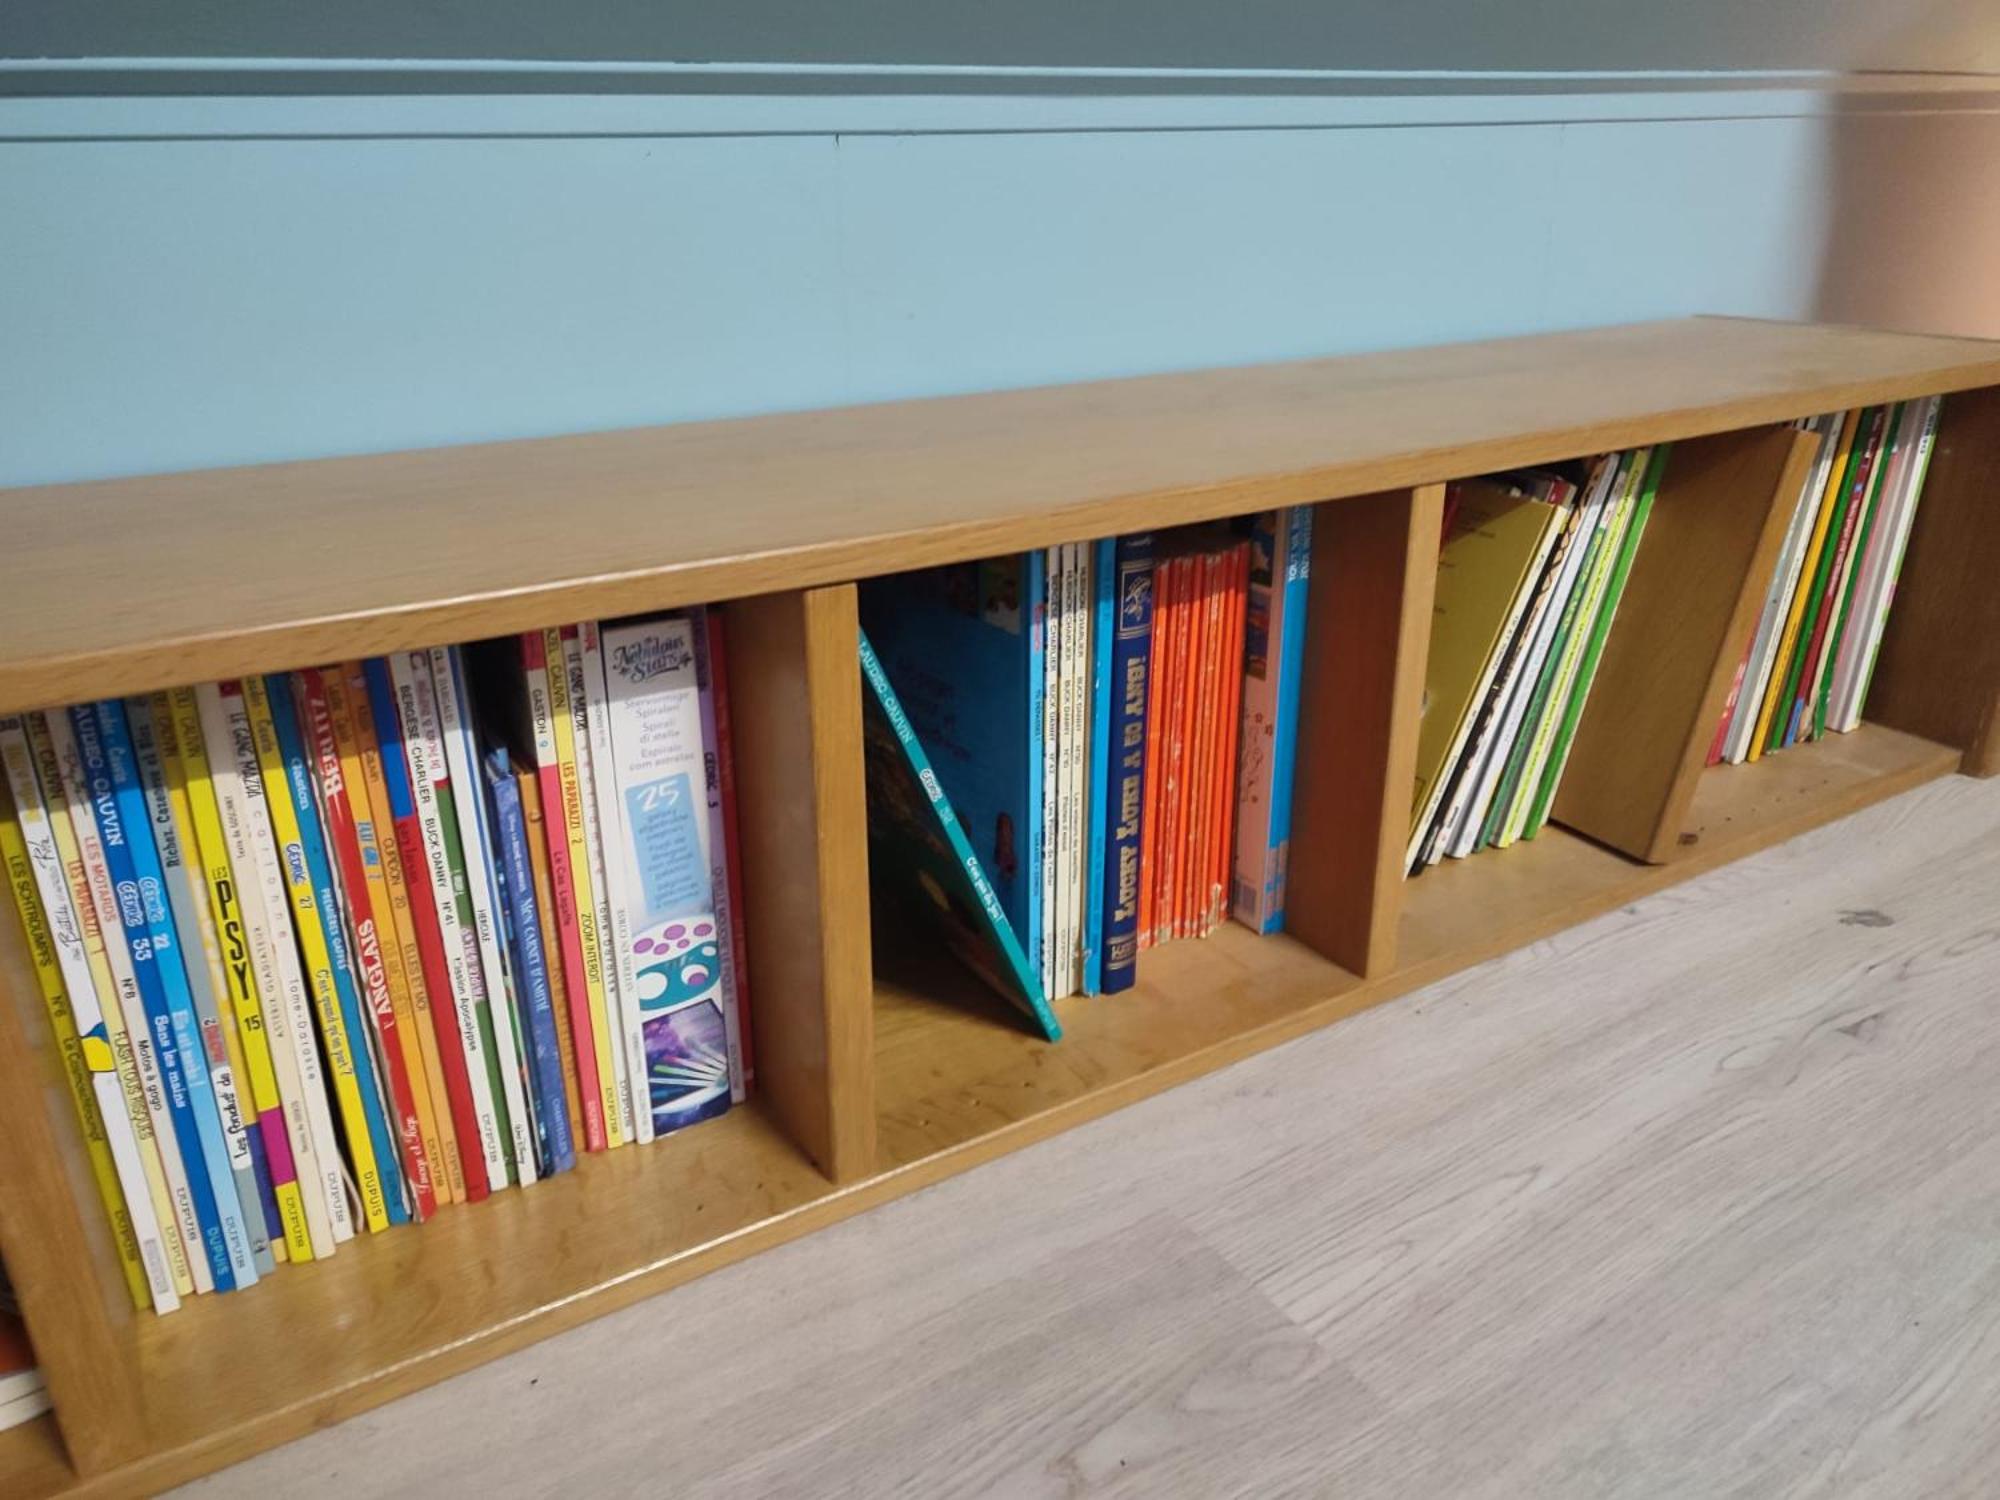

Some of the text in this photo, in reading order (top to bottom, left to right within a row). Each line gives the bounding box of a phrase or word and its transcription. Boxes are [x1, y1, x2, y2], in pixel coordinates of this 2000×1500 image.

[549, 663, 566, 708] CAUVIN
[531, 688, 546, 734] GASTON
[881, 695, 914, 744] CAUVIN
[305, 695, 344, 797] BERLITZ
[562, 760, 575, 777] LES
[409, 745, 432, 804] CHARLIER
[635, 779, 680, 812] 25
[91, 775, 123, 848] CAUVIN
[564, 779, 581, 829] PAPARAZZI
[423, 816, 439, 848] BUCK
[7, 854, 25, 879] LES
[83, 834, 116, 922] LES MOTARDS
[381, 837, 401, 886] CUPIDON
[430, 850, 447, 888] DANNY
[132, 936, 153, 961] 33
[214, 879, 254, 1001] PSY
[522, 925, 541, 965] CARNET
[580, 912, 594, 941] ZOOM
[403, 942, 420, 975] ELLES
[243, 1014, 261, 1031] 15
[457, 996, 479, 1052] Apocalypse
[136, 1038, 155, 1072] Motos
[152, 1013, 190, 1108] Sans les mains
[145, 1084, 163, 1112] gogo
[480, 1112, 498, 1162] DUPUIS
[174, 1186, 197, 1241] DUPUIS
[326, 1171, 344, 1223] DUPUIS
[363, 1170, 383, 1216] DUPUIS
[285, 1195, 304, 1248] DUPUIS
[205, 1226, 229, 1276] DUPUIS
